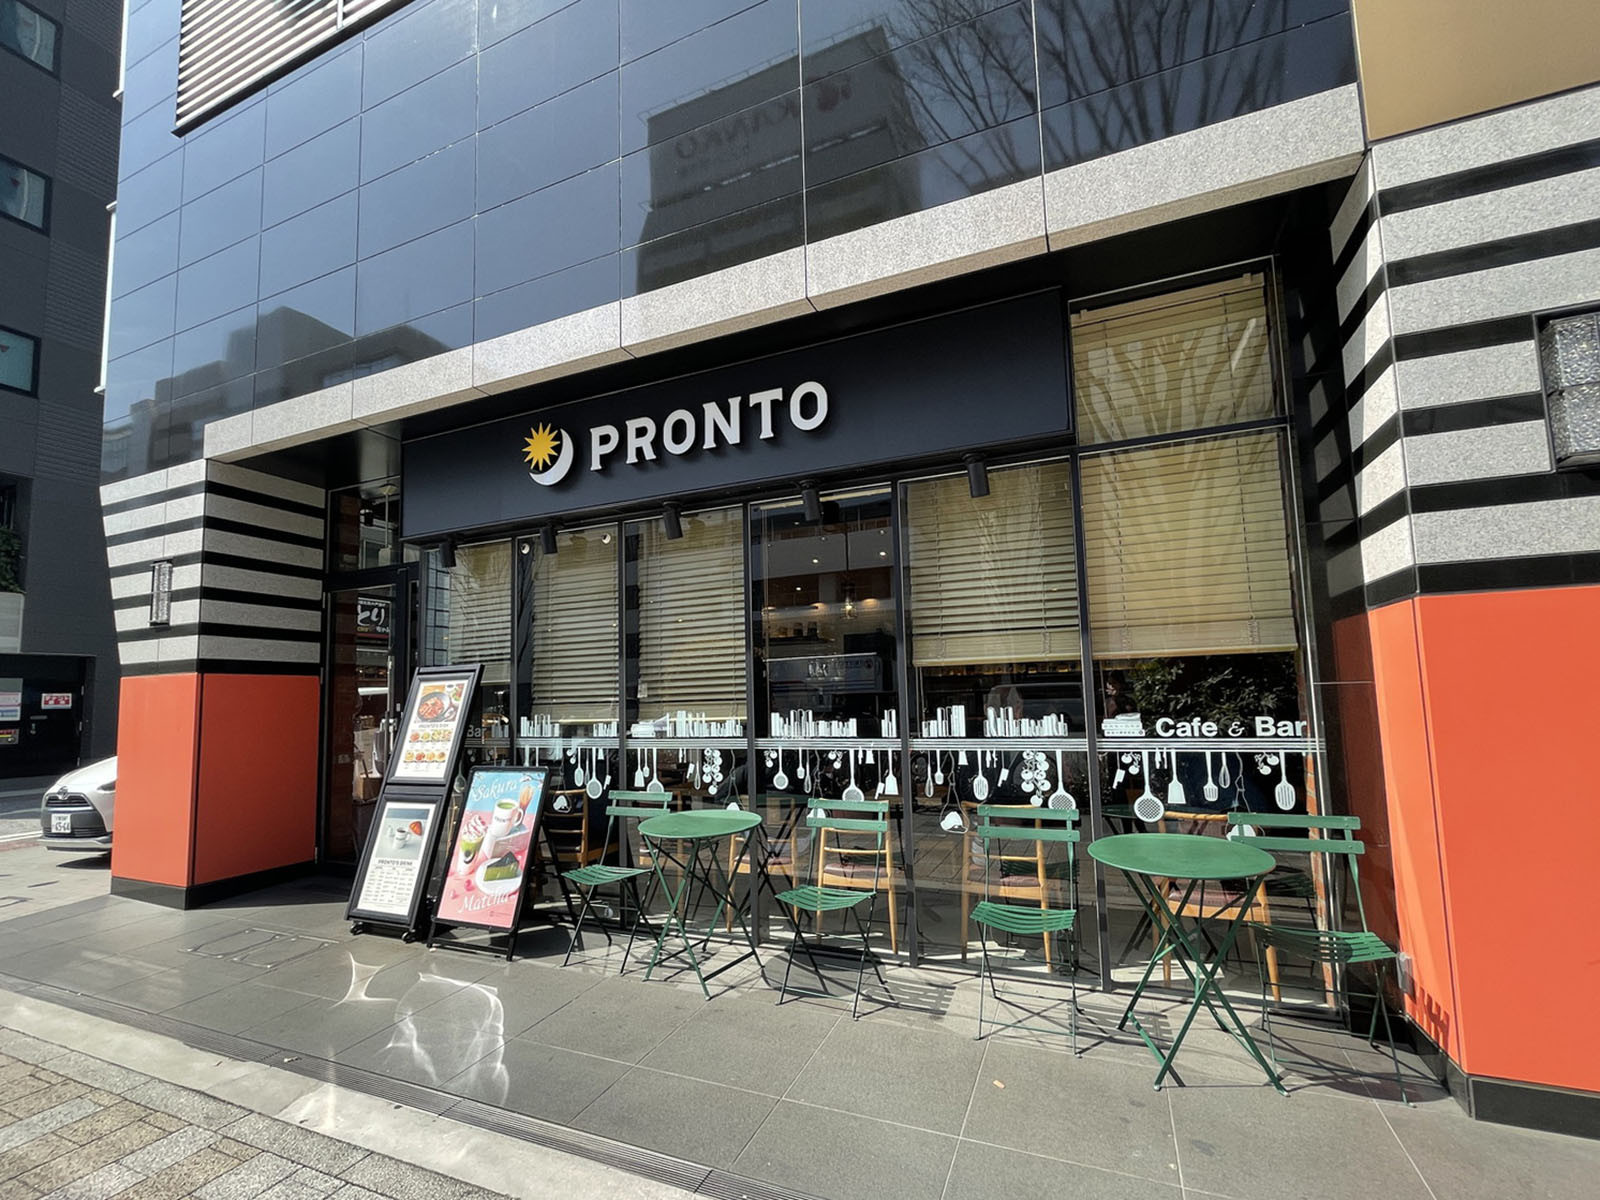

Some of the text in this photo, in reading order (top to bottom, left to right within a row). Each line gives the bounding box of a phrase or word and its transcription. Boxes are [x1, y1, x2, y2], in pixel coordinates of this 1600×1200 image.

[590, 381, 829, 471] PRONTO
[466, 724, 487, 738] Bar
[1155, 716, 1307, 737] Cafe & Bar
[472, 779, 518, 801] Sakura
[458, 887, 510, 913] Matcha
